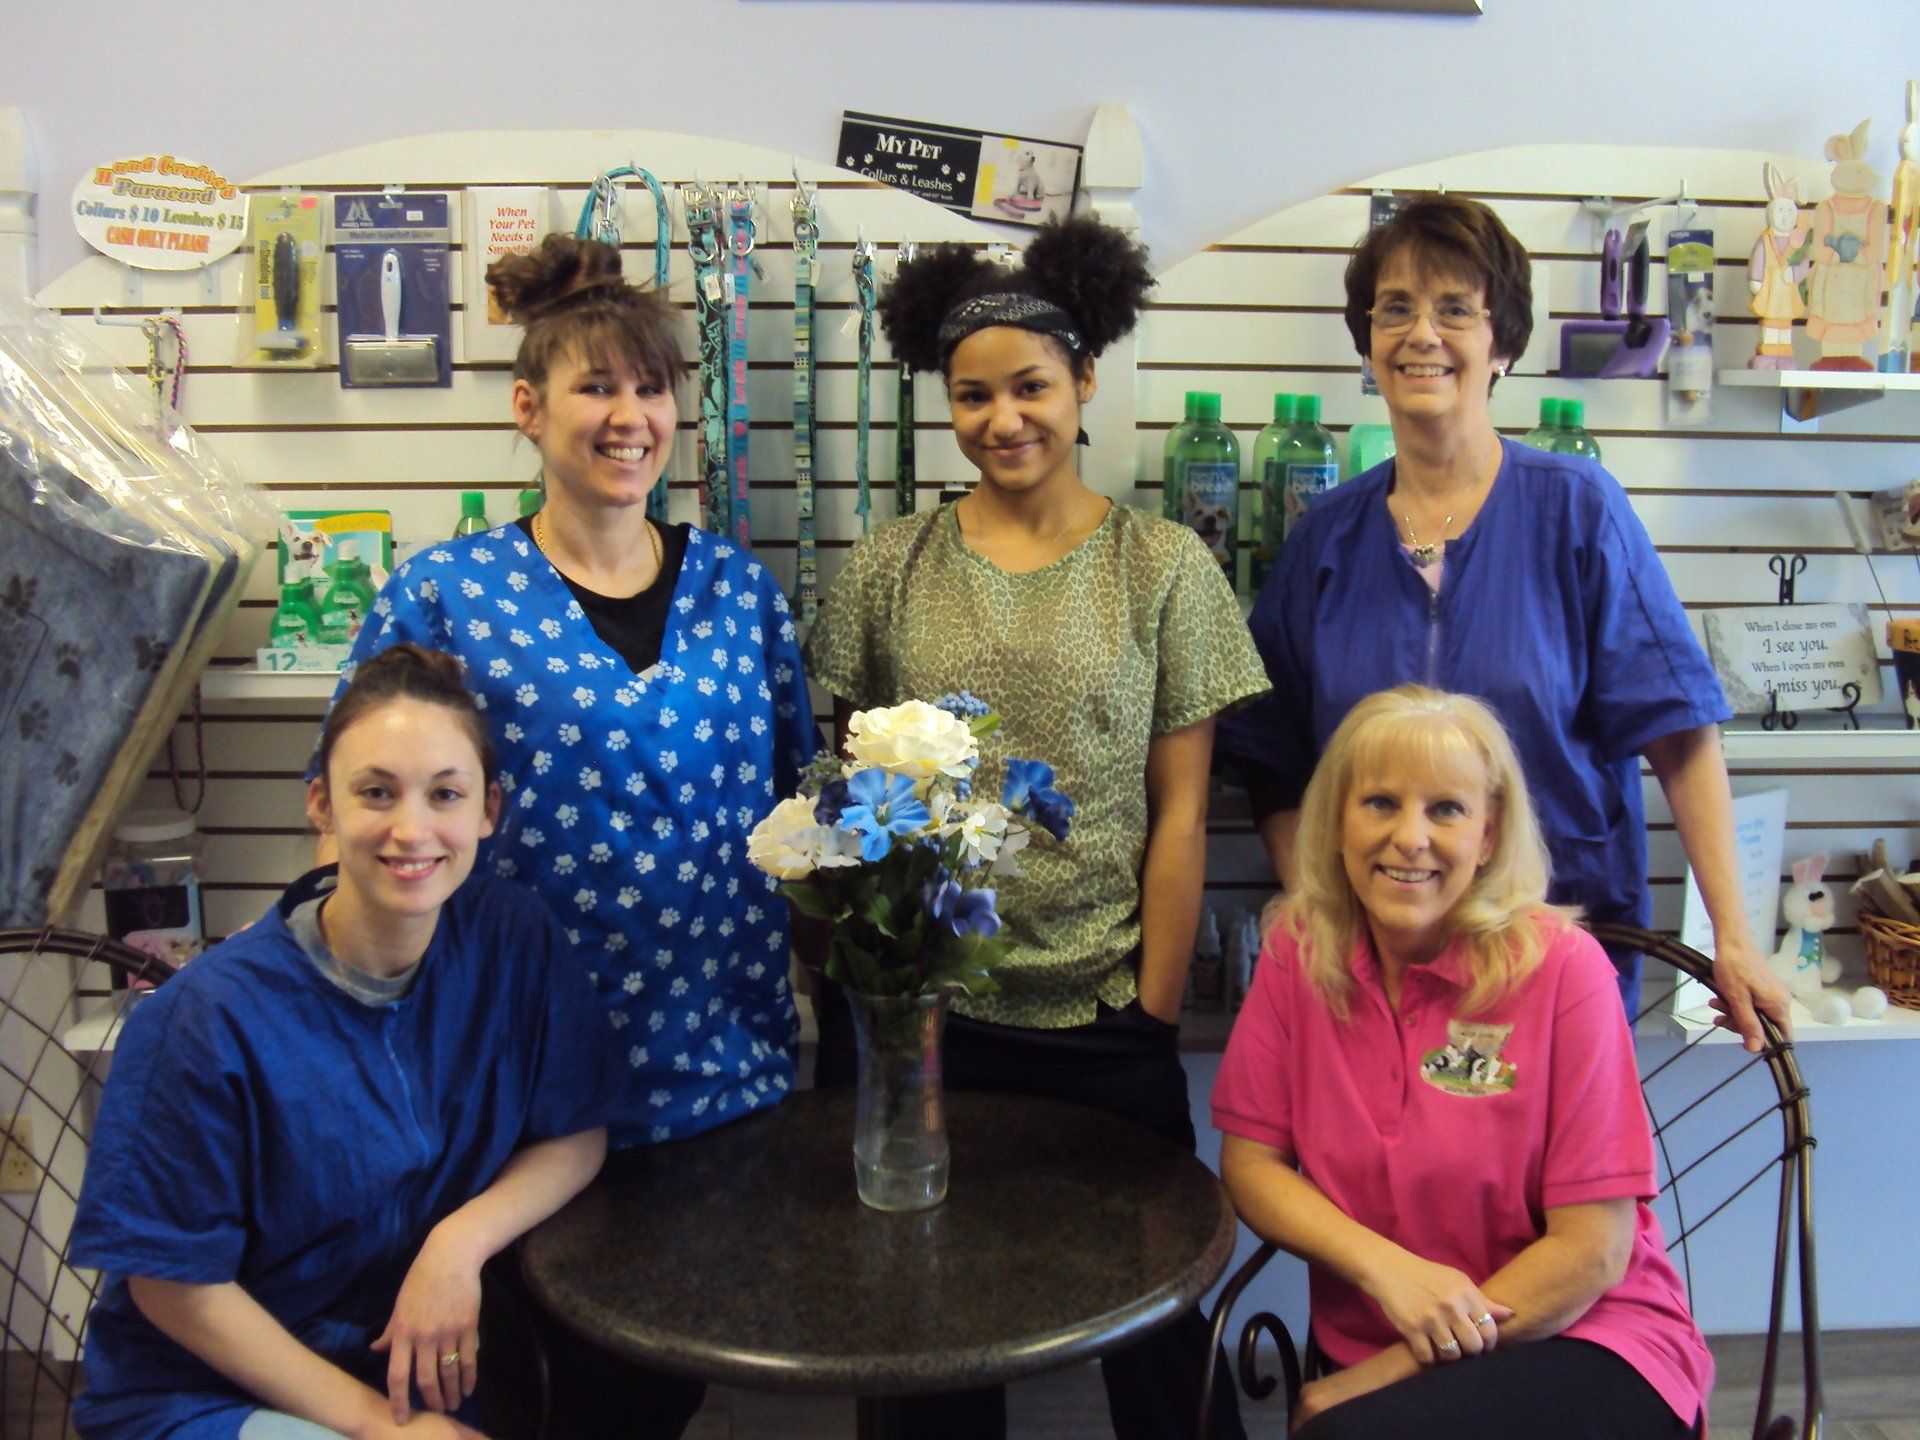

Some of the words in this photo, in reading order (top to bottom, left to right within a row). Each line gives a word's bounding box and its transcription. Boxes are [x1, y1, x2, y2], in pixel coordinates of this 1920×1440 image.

[875, 133, 905, 155] MY
[908, 138, 943, 160] PET
[94, 157, 156, 185] Hand
[158, 156, 236, 199] Crafted
[860, 167, 897, 183] Collars
[900, 175, 909, 186] &
[912, 175, 953, 192] Leashes
[112, 178, 216, 204] Paracord
[76, 200, 126, 221] Collars
[129, 204, 139, 224] $
[142, 207, 159, 223] 10
[163, 208, 214, 228] Leashes
[217, 213, 227, 231] $
[497, 207, 527, 217] When
[489, 219, 514, 230] Your
[518, 219, 536, 230] Pet
[106, 226, 135, 245] CASH
[137, 229, 164, 249] ONLY
[167, 232, 210, 254] PLEASE
[491, 232, 523, 242] Needs
[526, 233, 534, 242] a
[1745, 622, 1773, 632] When
[1775, 622, 1780, 631] I
[1781, 621, 1802, 631] close
[1805, 622, 1818, 632] my
[1820, 621, 1837, 631] eyes
[1763, 638, 1771, 653] I
[1776, 640, 1795, 653] see
[1799, 638, 1829, 660] you.
[266, 652, 297, 671] 12
[1751, 662, 1781, 673] When
[1782, 661, 1787, 671] I
[1788, 662, 1811, 673] open
[1813, 661, 1826, 671] my
[1827, 660, 1846, 671] eyes
[1764, 679, 1772, 695] I
[1777, 679, 1808, 693] miss
[1811, 677, 1842, 700] you.
